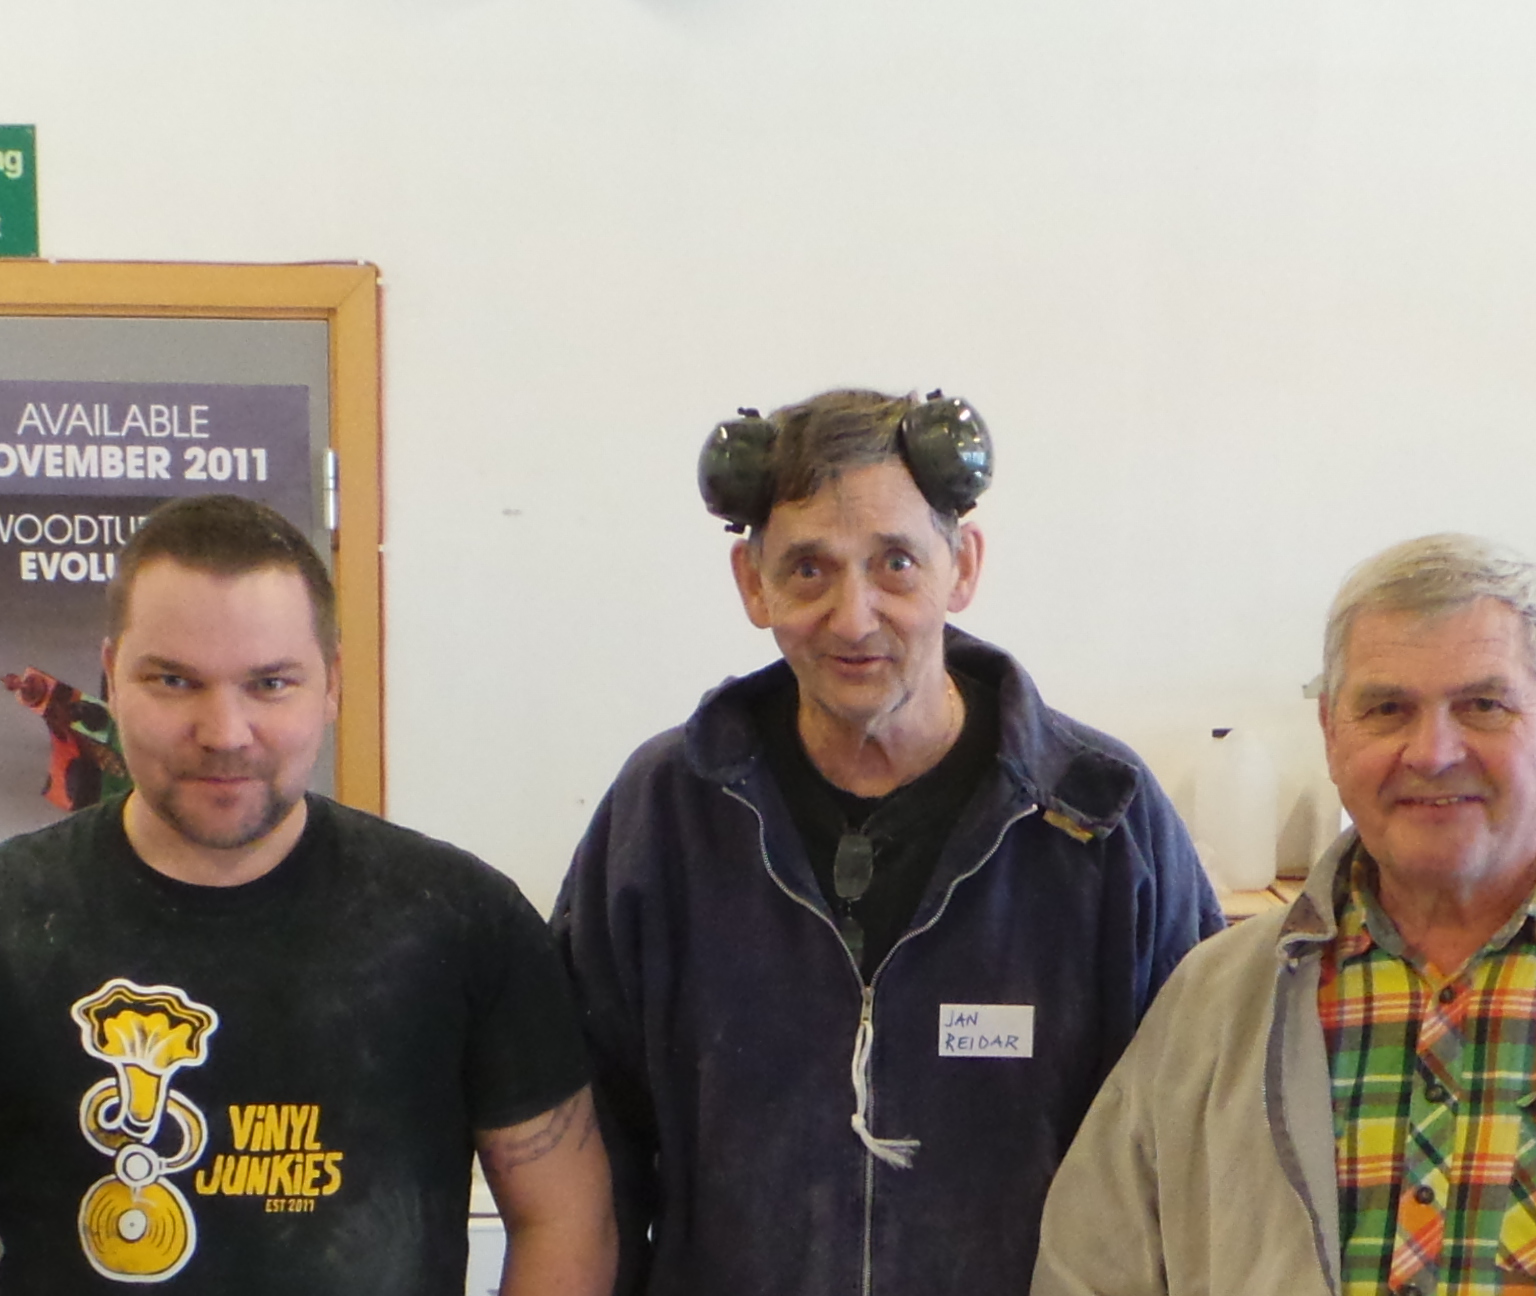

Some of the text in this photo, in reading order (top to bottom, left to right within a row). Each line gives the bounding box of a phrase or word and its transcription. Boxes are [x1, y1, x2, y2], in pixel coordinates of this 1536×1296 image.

[17, 402, 209, 438] AVAILABLE
[183, 446, 268, 481] 2011
[944, 1010, 979, 1028] JAN
[945, 1032, 1020, 1053] REIDAR
[265, 1198, 315, 1213] EST 2011
